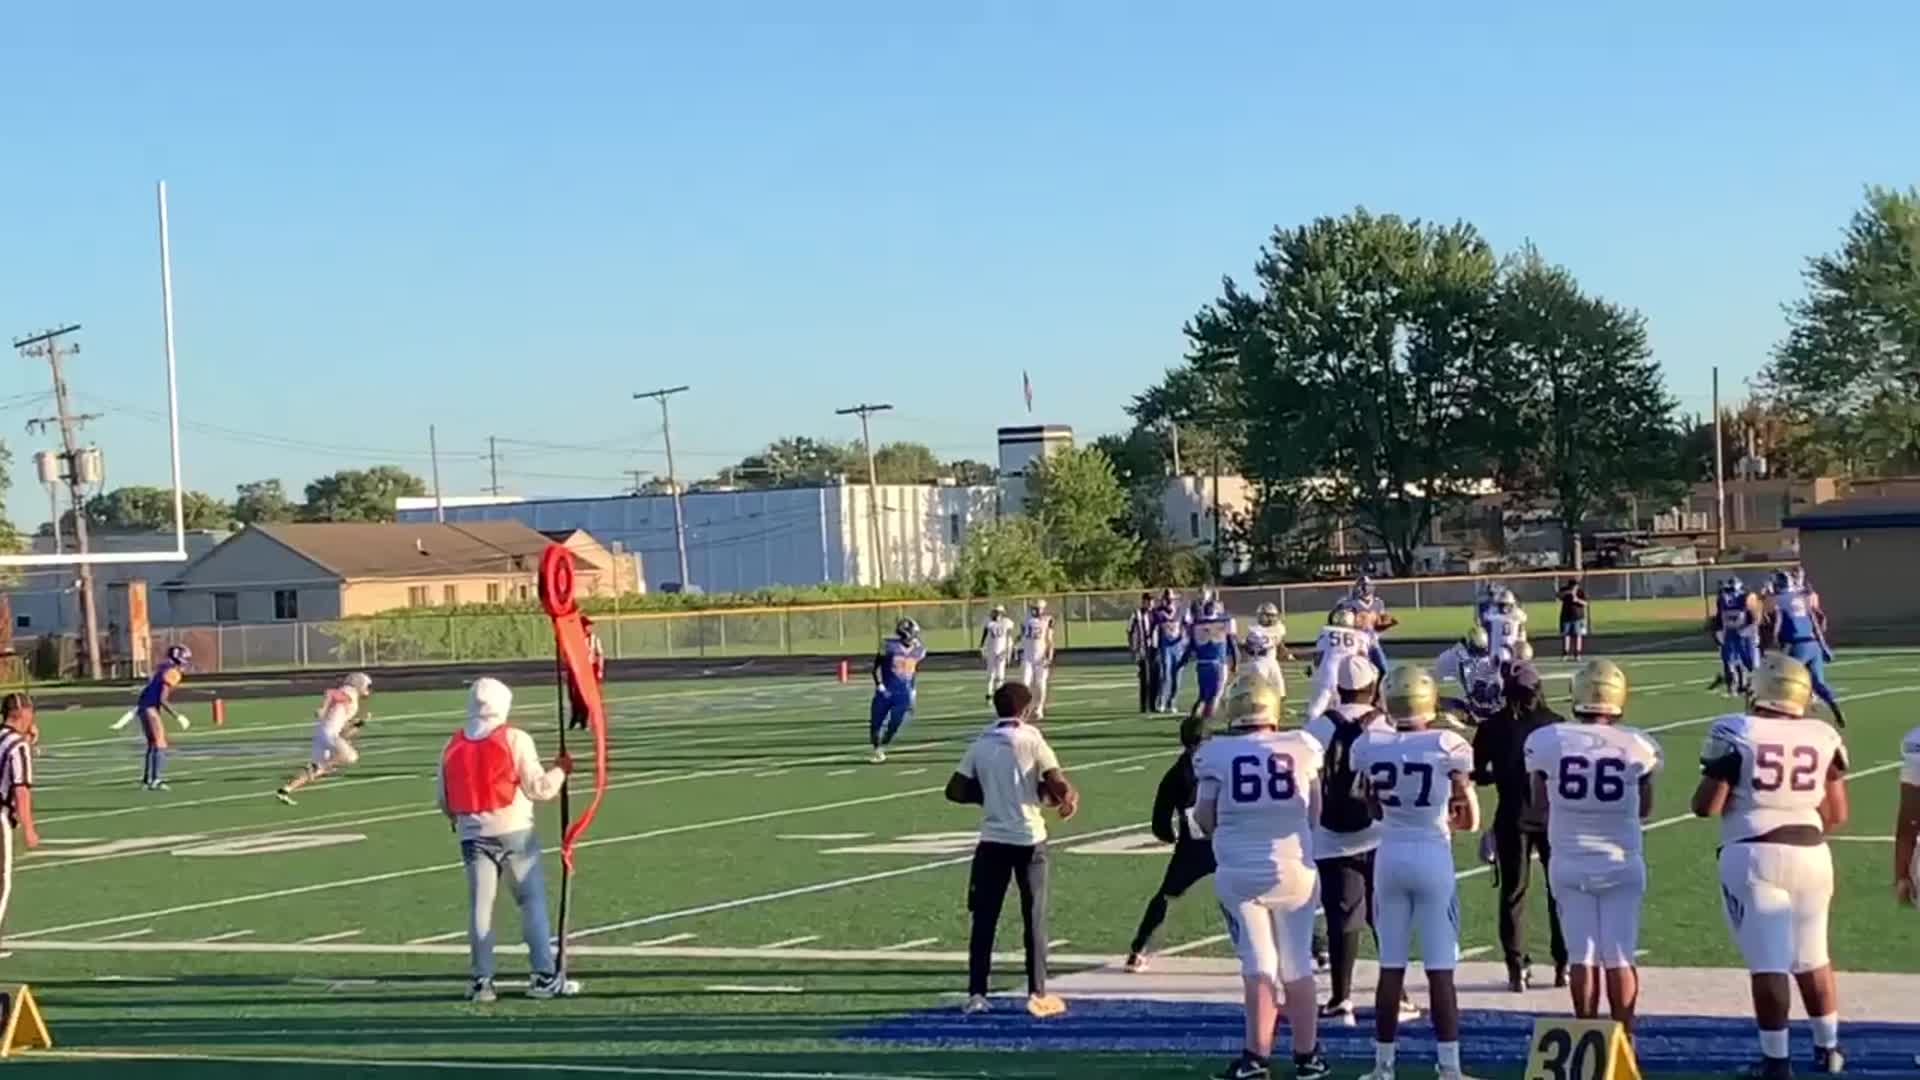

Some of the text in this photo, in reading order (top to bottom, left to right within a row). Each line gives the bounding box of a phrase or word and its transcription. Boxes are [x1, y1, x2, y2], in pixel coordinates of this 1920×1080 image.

[1329, 631, 1354, 647] 56
[1232, 753, 1296, 803] 68
[1371, 762, 1434, 808] 27
[1558, 756, 1626, 802] 66
[1752, 743, 1819, 792] 52
[1536, 1028, 1606, 1080] 30
